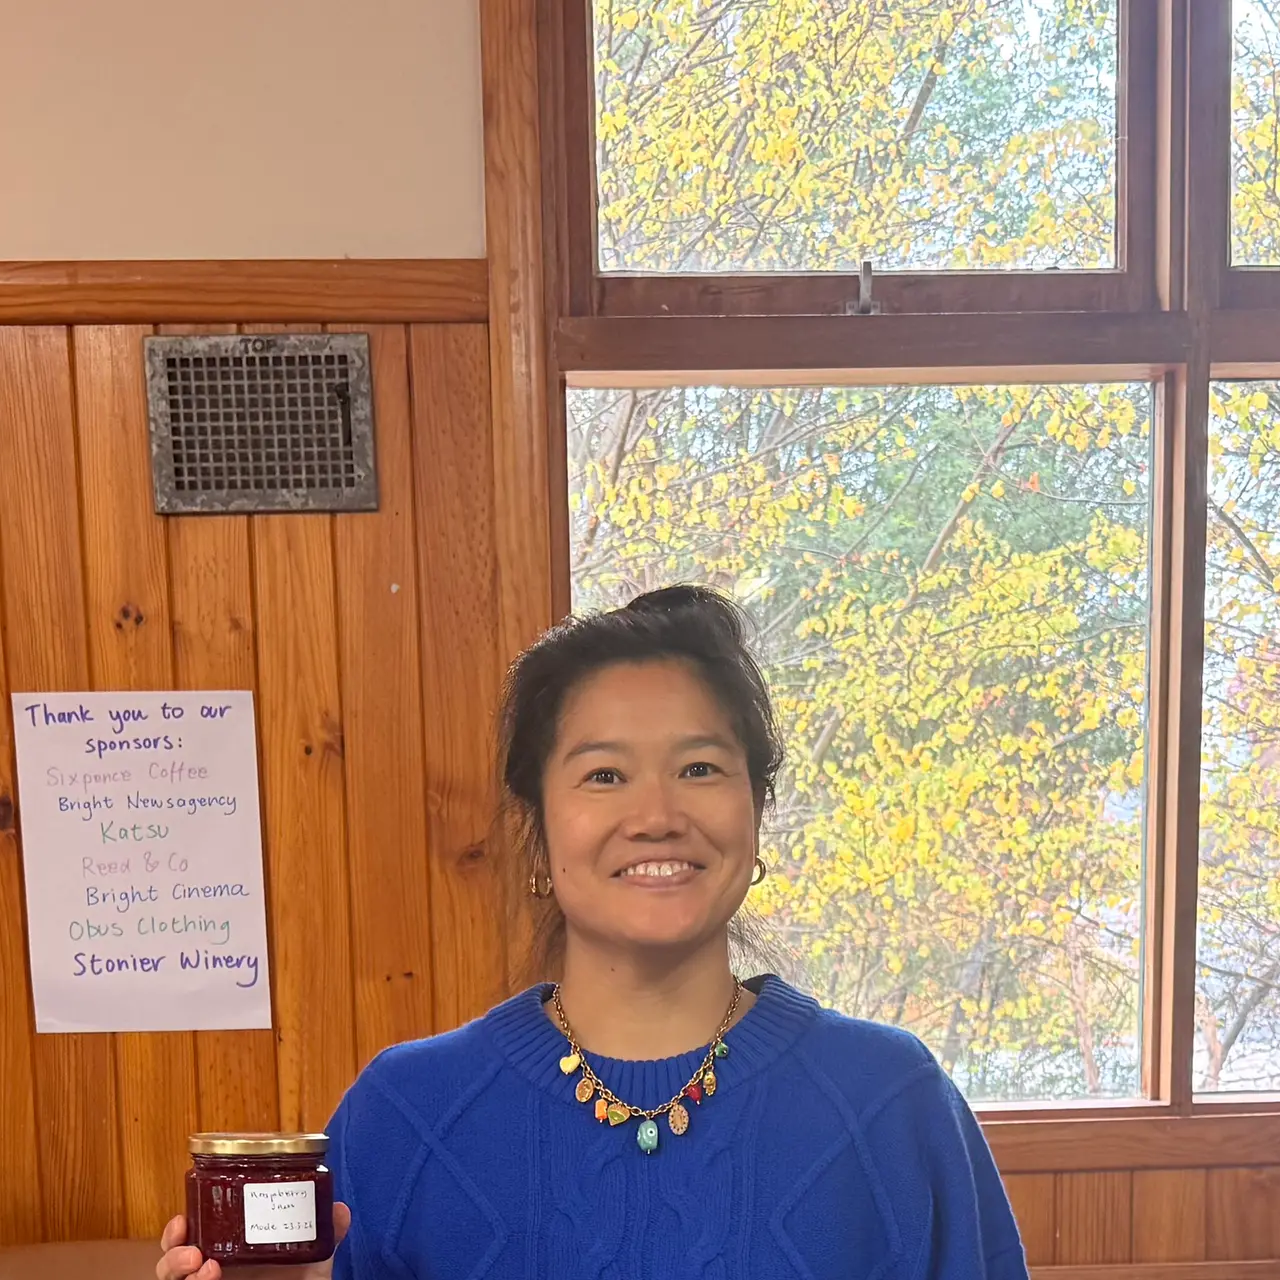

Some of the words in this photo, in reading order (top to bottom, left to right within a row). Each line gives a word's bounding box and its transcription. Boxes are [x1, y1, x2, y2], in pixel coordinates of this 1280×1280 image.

[25, 704, 94, 727] Thank
[109, 709, 148, 734] you
[161, 702, 184, 719] to
[200, 704, 232, 719] our
[85, 735, 183, 759] sponsors:
[46, 767, 132, 793] Sixpence
[149, 760, 209, 780] Coffee
[58, 796, 113, 821] Bright
[127, 791, 237, 815] Newsagency
[101, 821, 169, 843] Katsu
[82, 855, 132, 878] Reed
[145, 851, 160, 873] &
[168, 854, 189, 873] Co
[86, 886, 159, 912] Bright
[171, 883, 250, 900] Cinema
[69, 918, 123, 941] Obus
[137, 915, 231, 945] Clothing
[73, 952, 166, 977] Stonier
[180, 949, 259, 987] Winery
